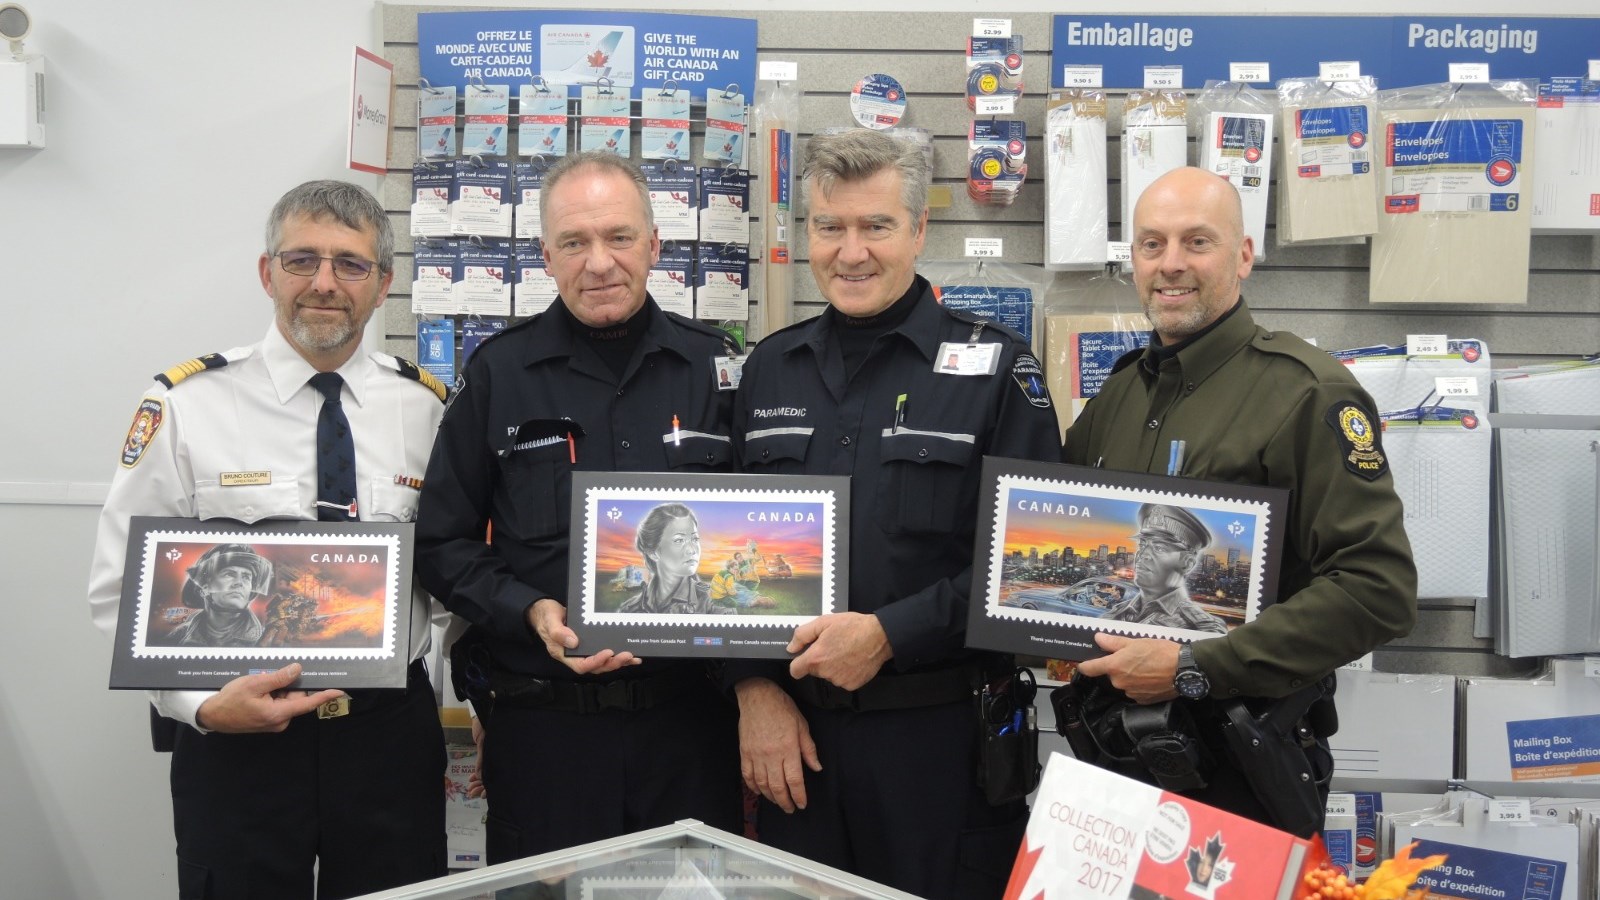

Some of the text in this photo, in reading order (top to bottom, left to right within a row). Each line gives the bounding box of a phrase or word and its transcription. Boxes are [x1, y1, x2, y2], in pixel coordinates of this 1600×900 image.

[476, 31, 532, 41] OFFREZ LE
[643, 33, 697, 45] GIVE THE
[1067, 21, 1193, 52] Emballage
[1408, 23, 1538, 54] Packaging
[435, 42, 532, 55] MONDE AVEC UNE
[643, 45, 740, 60] WORLD WITH AN
[450, 55, 532, 66] CARTE-CADEAU
[643, 57, 719, 71] AIR CANADA
[464, 67, 532, 78] AIR CANADA
[643, 69, 669, 80] GIFT
[671, 71, 705, 82] CARD
[1076, 101, 1087, 112] 10
[1155, 101, 1167, 112] 10
[1302, 117, 1332, 126] Envelopes
[1302, 127, 1336, 136] Enveloppes
[1394, 136, 1444, 147] Envelopes
[1394, 150, 1450, 162] Enveloppes
[1361, 163, 1369, 173] 6
[1248, 177, 1260, 186] 40
[1506, 194, 1517, 210] 6
[963, 292, 998, 300] Smartphone
[753, 407, 807, 418] PARAMEDIC
[1358, 462, 1379, 470] POLICE
[1017, 499, 1091, 518] CANADA
[747, 511, 816, 522] CANADA
[310, 553, 380, 563] CANADA
[1513, 736, 1572, 748] Mailing Box
[1515, 750, 1541, 762] Boîte
[1049, 801, 1137, 848] COLLECTION
[1072, 834, 1128, 871] CANADA
[1454, 865, 1475, 877] Box
[1077, 862, 1123, 896] 2017
[1416, 874, 1505, 898] oîte d'expédition
